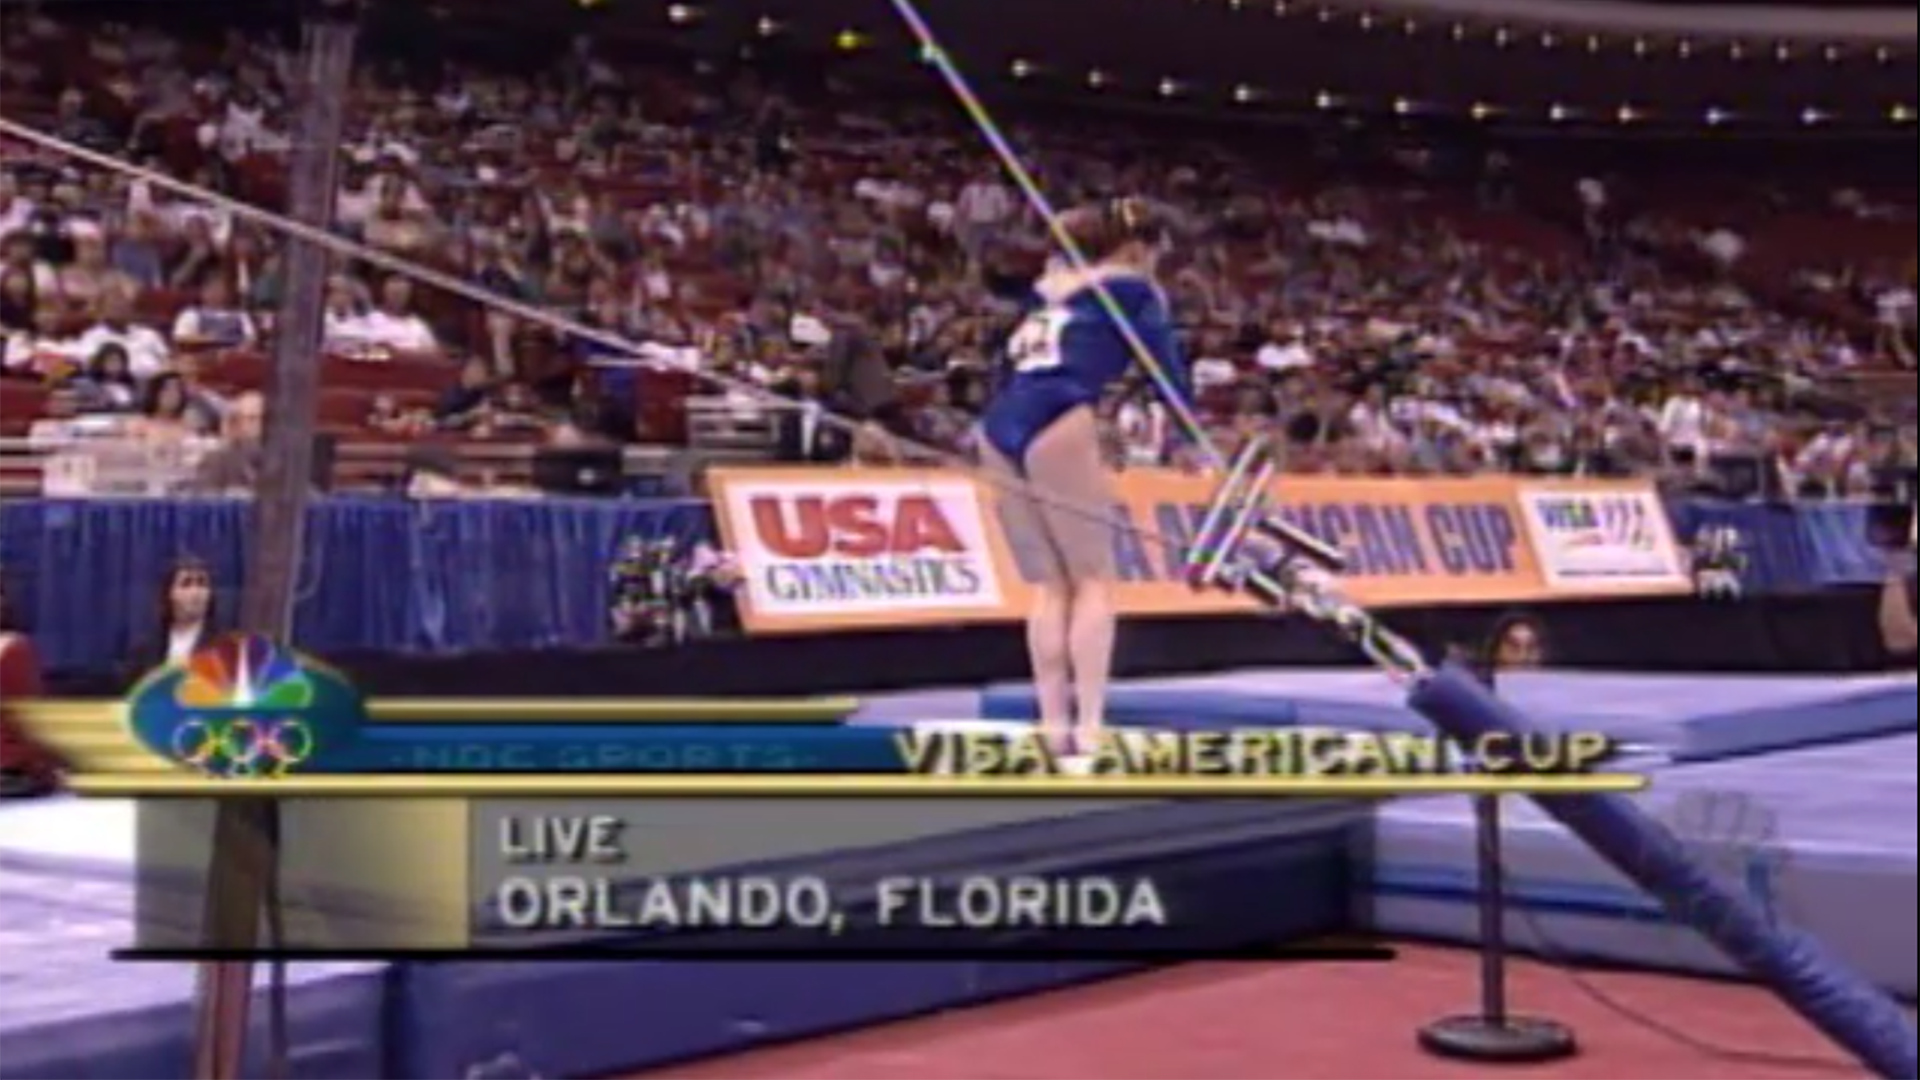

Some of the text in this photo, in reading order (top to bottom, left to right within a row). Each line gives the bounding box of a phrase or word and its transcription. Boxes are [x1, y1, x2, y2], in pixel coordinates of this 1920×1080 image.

[749, 495, 967, 557] USA
[1425, 500, 1519, 576] CUP
[764, 560, 982, 600] GYMNASTICS
